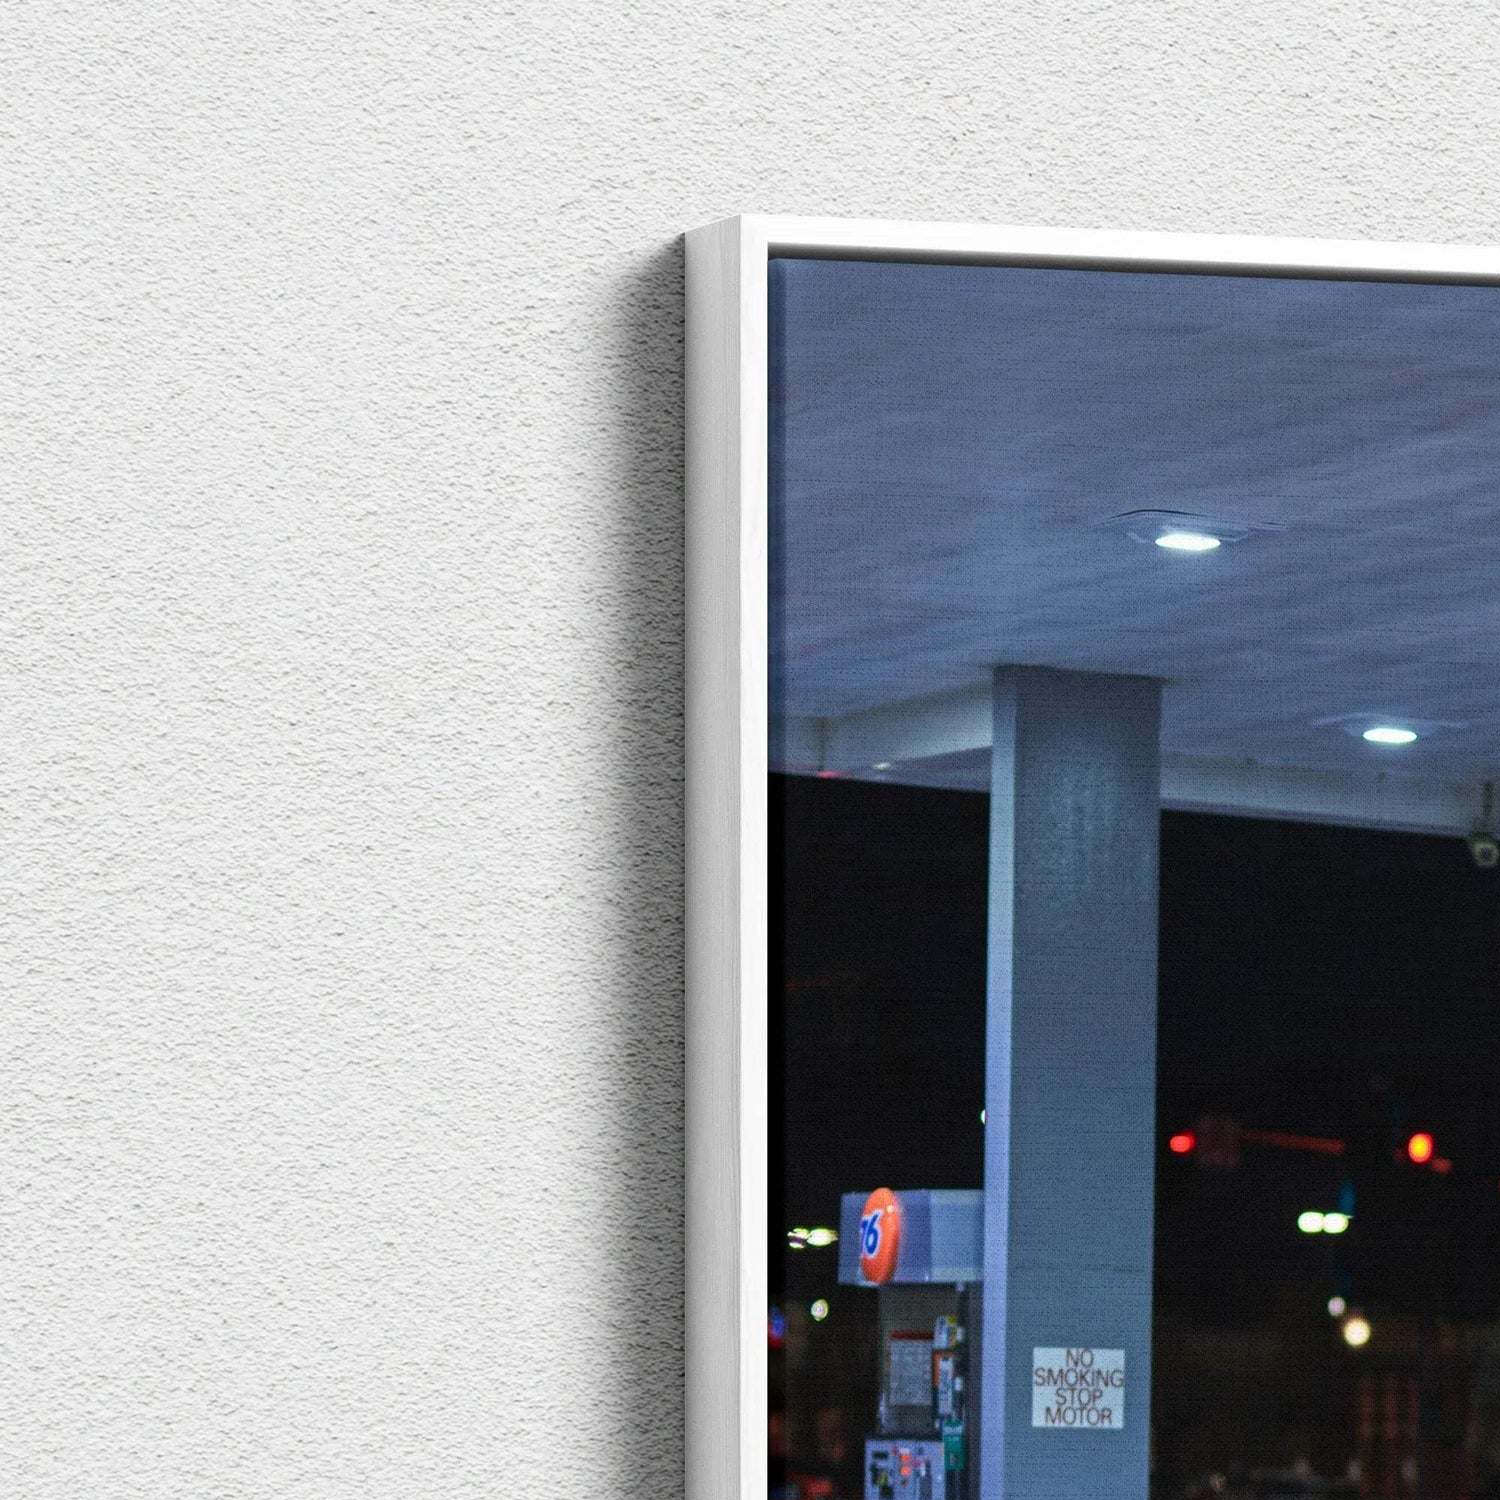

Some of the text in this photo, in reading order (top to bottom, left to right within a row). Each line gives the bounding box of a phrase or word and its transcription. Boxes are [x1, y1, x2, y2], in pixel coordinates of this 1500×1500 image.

[860, 1209, 884, 1259] 76
[1066, 1348, 1094, 1368] NO
[1034, 1367, 1124, 1388] SMOKING
[1056, 1387, 1103, 1407] STOP
[1045, 1406, 1113, 1426] MOTOR
